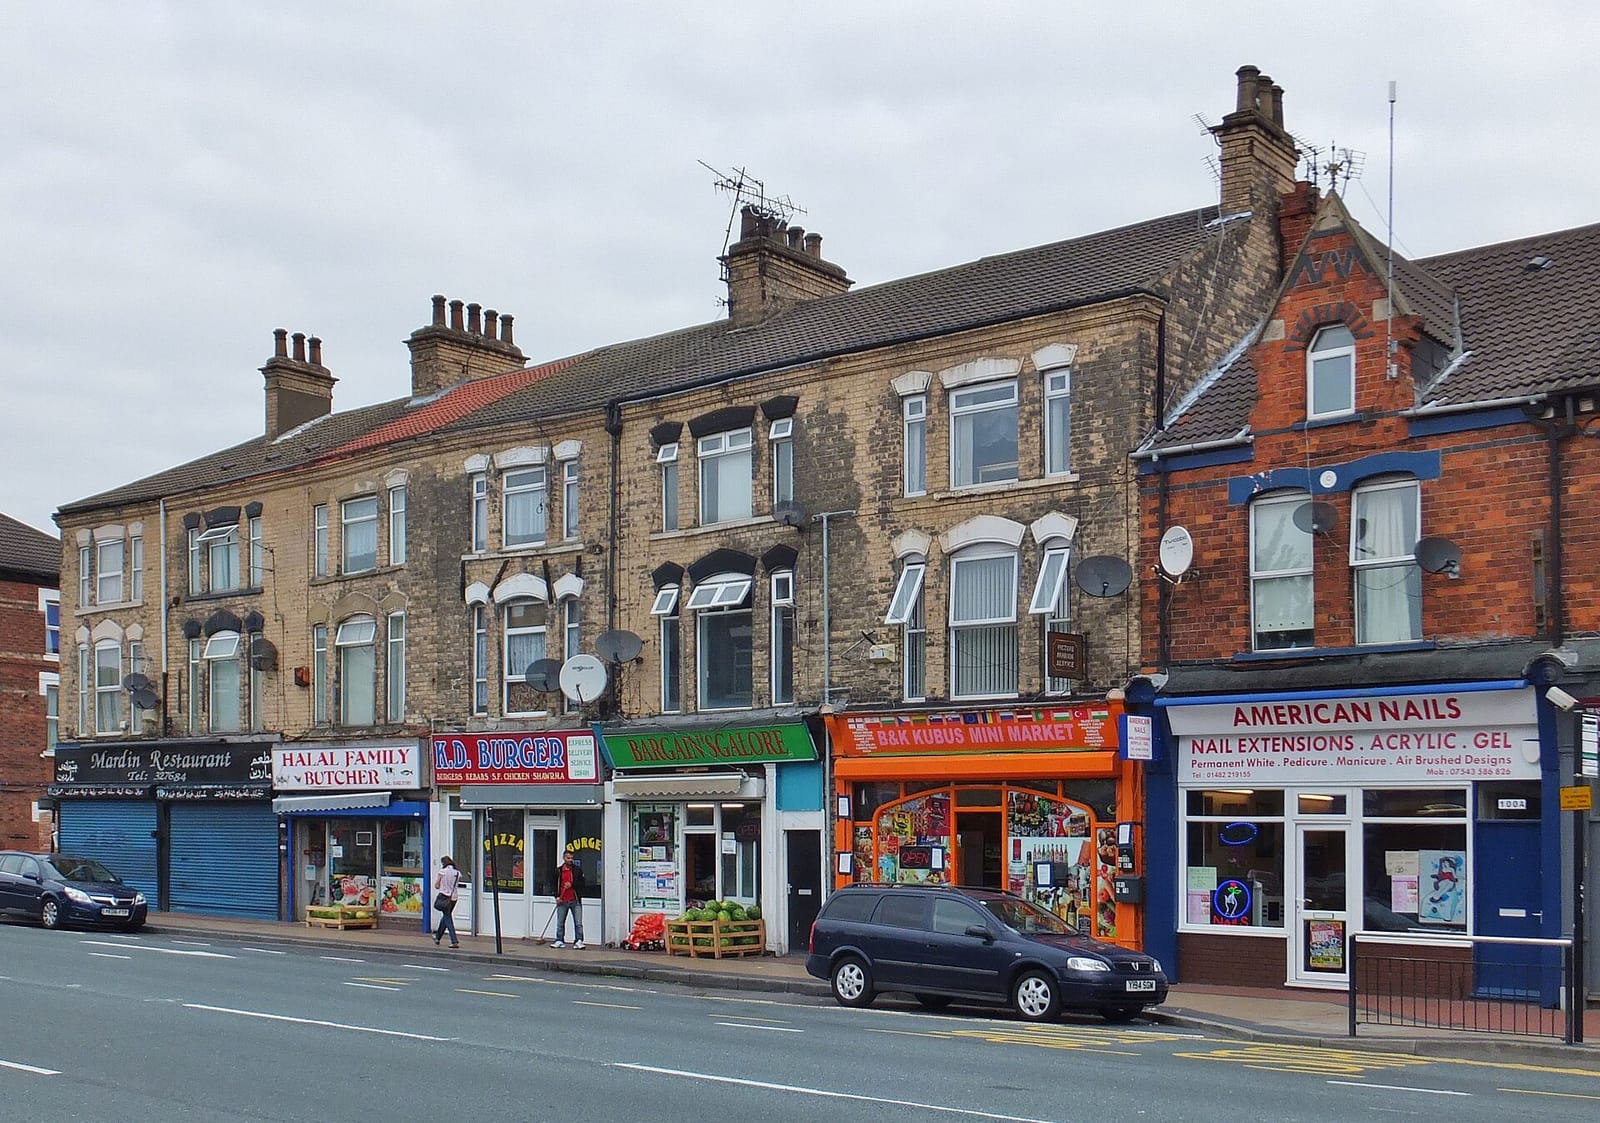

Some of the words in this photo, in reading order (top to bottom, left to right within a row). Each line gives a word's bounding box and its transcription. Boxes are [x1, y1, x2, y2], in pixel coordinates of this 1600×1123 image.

[1233, 702, 1373, 727] AMERICAN
[1378, 697, 1462, 721] NAILS
[877, 730, 910, 746] B&K
[912, 728, 964, 745] KUBUS
[968, 726, 1004, 743] MINI
[1007, 724, 1074, 742] MARKET
[1191, 739, 1232, 755] NAIL
[1238, 735, 1354, 753] EXTENSIONS
[1370, 732, 1457, 751] ACRYLIC
[1473, 732, 1512, 750] GEL
[91, 749, 141, 769] Mardin
[150, 750, 231, 771] Restaurant
[282, 751, 339, 767] HALAL
[345, 748, 410, 769] FAMILY
[434, 740, 471, 769] K.D.
[478, 737, 565, 770] BURGER
[1191, 759, 1244, 769] Permanent
[1247, 757, 1275, 768] White
[1283, 757, 1328, 767] Pedicure
[1336, 756, 1387, 766] Manicure
[1395, 755, 1409, 766] Air
[1415, 755, 1462, 766] Brushed
[1465, 754, 1512, 769] Designs
[127, 770, 148, 781] Tel:
[304, 769, 380, 786] BUTCHER
[436, 772, 463, 781] BURGERS
[466, 771, 489, 781] KEBABS
[504, 771, 531, 780] CHICKEN
[901, 851, 929, 864] OPEN
